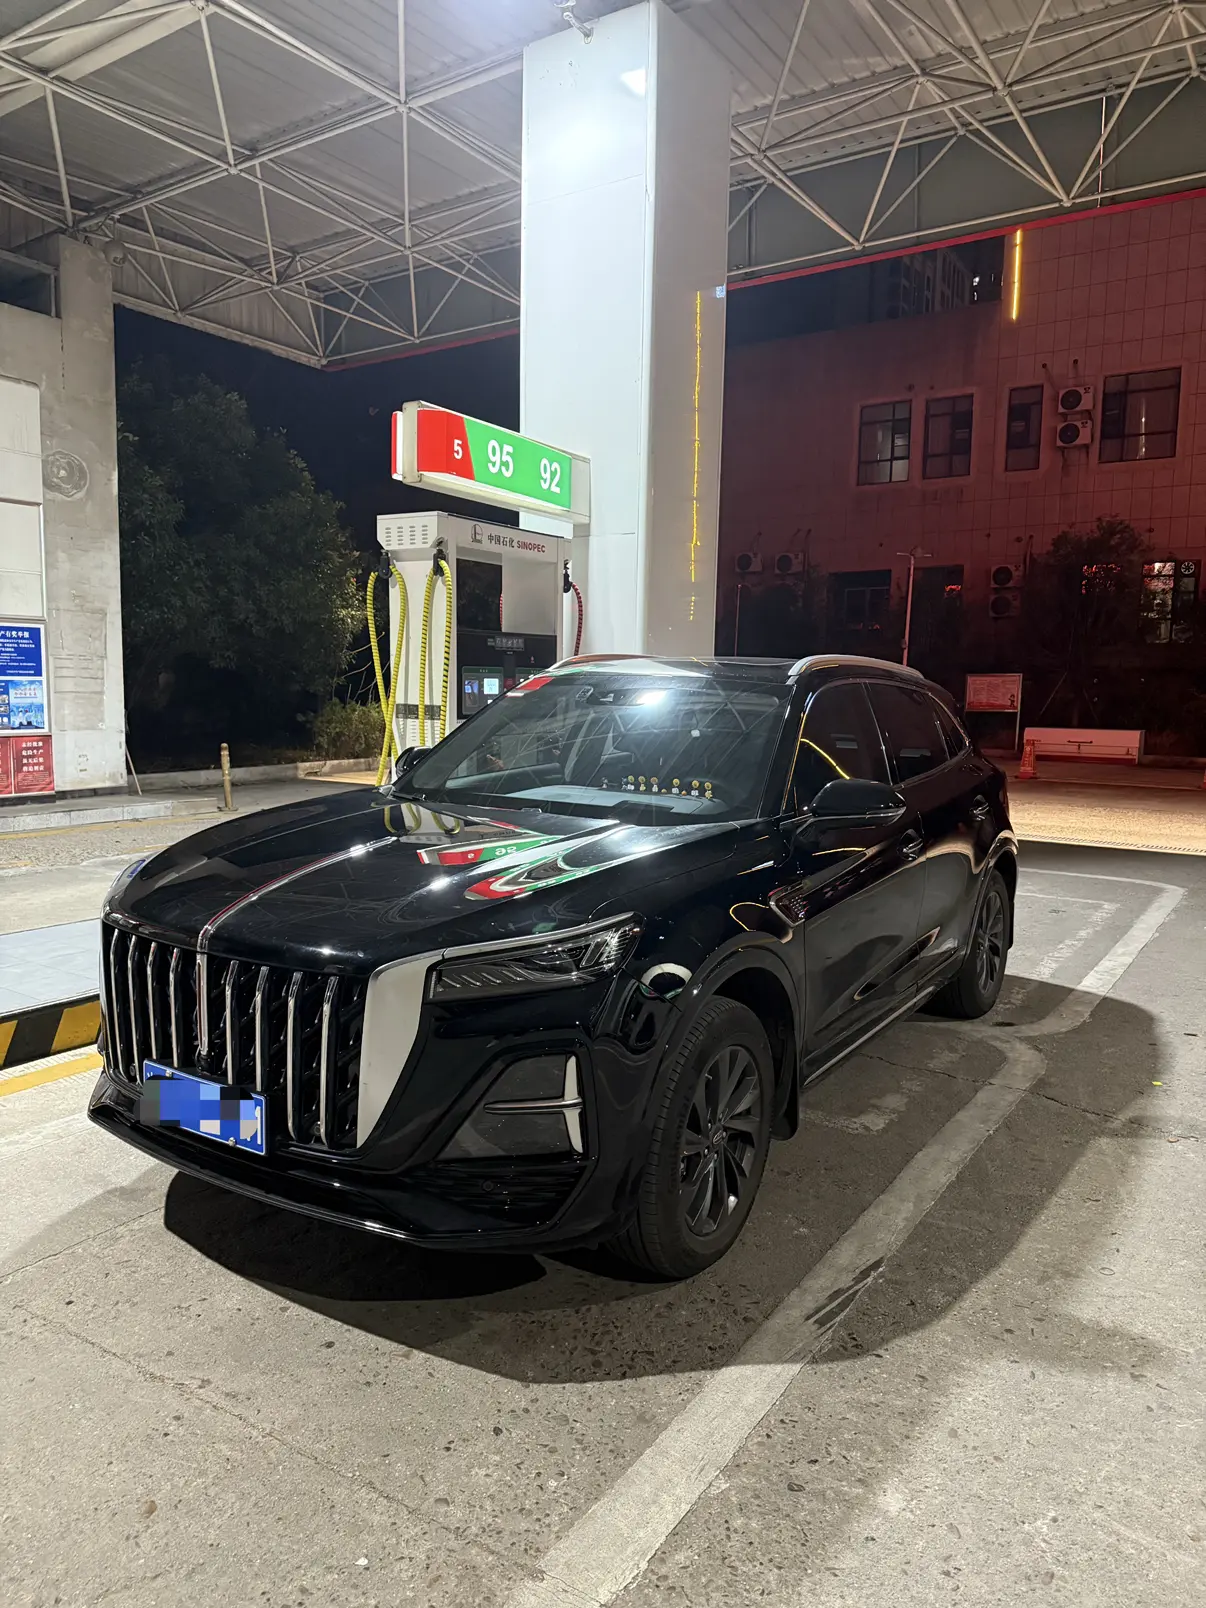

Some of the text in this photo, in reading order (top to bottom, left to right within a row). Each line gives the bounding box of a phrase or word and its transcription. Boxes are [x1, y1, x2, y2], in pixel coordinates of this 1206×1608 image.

[453, 439, 561, 494] 5 95 92
[487, 533, 546, 553] 中国石化 SINOPEC
